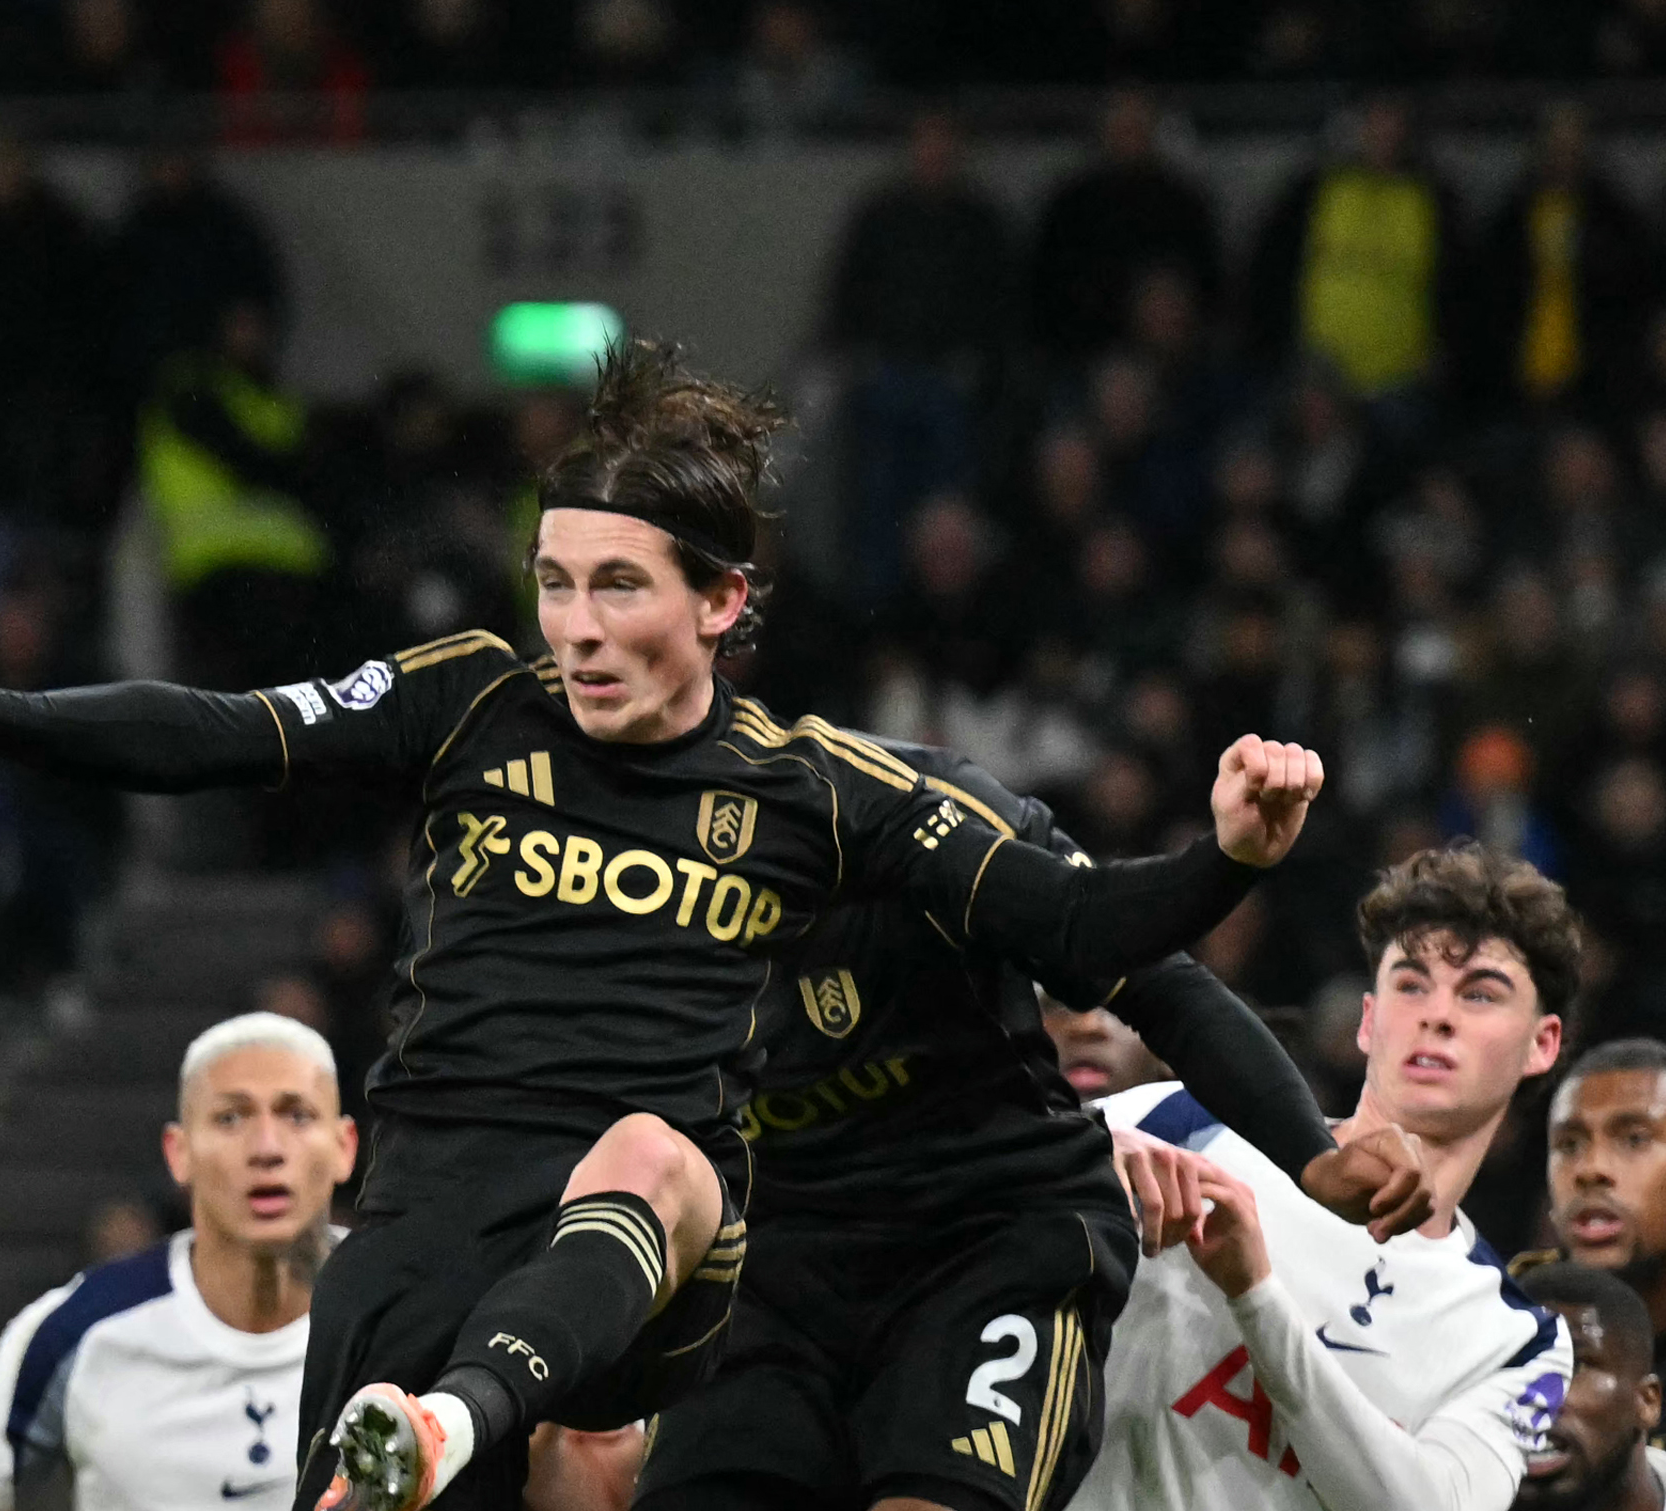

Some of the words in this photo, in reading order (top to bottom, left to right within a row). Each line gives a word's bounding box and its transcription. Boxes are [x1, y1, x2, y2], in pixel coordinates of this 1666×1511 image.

[514, 830, 782, 947] SBOTOP
[488, 1331, 549, 1381] FFC
[965, 1314, 1038, 1426] 2
